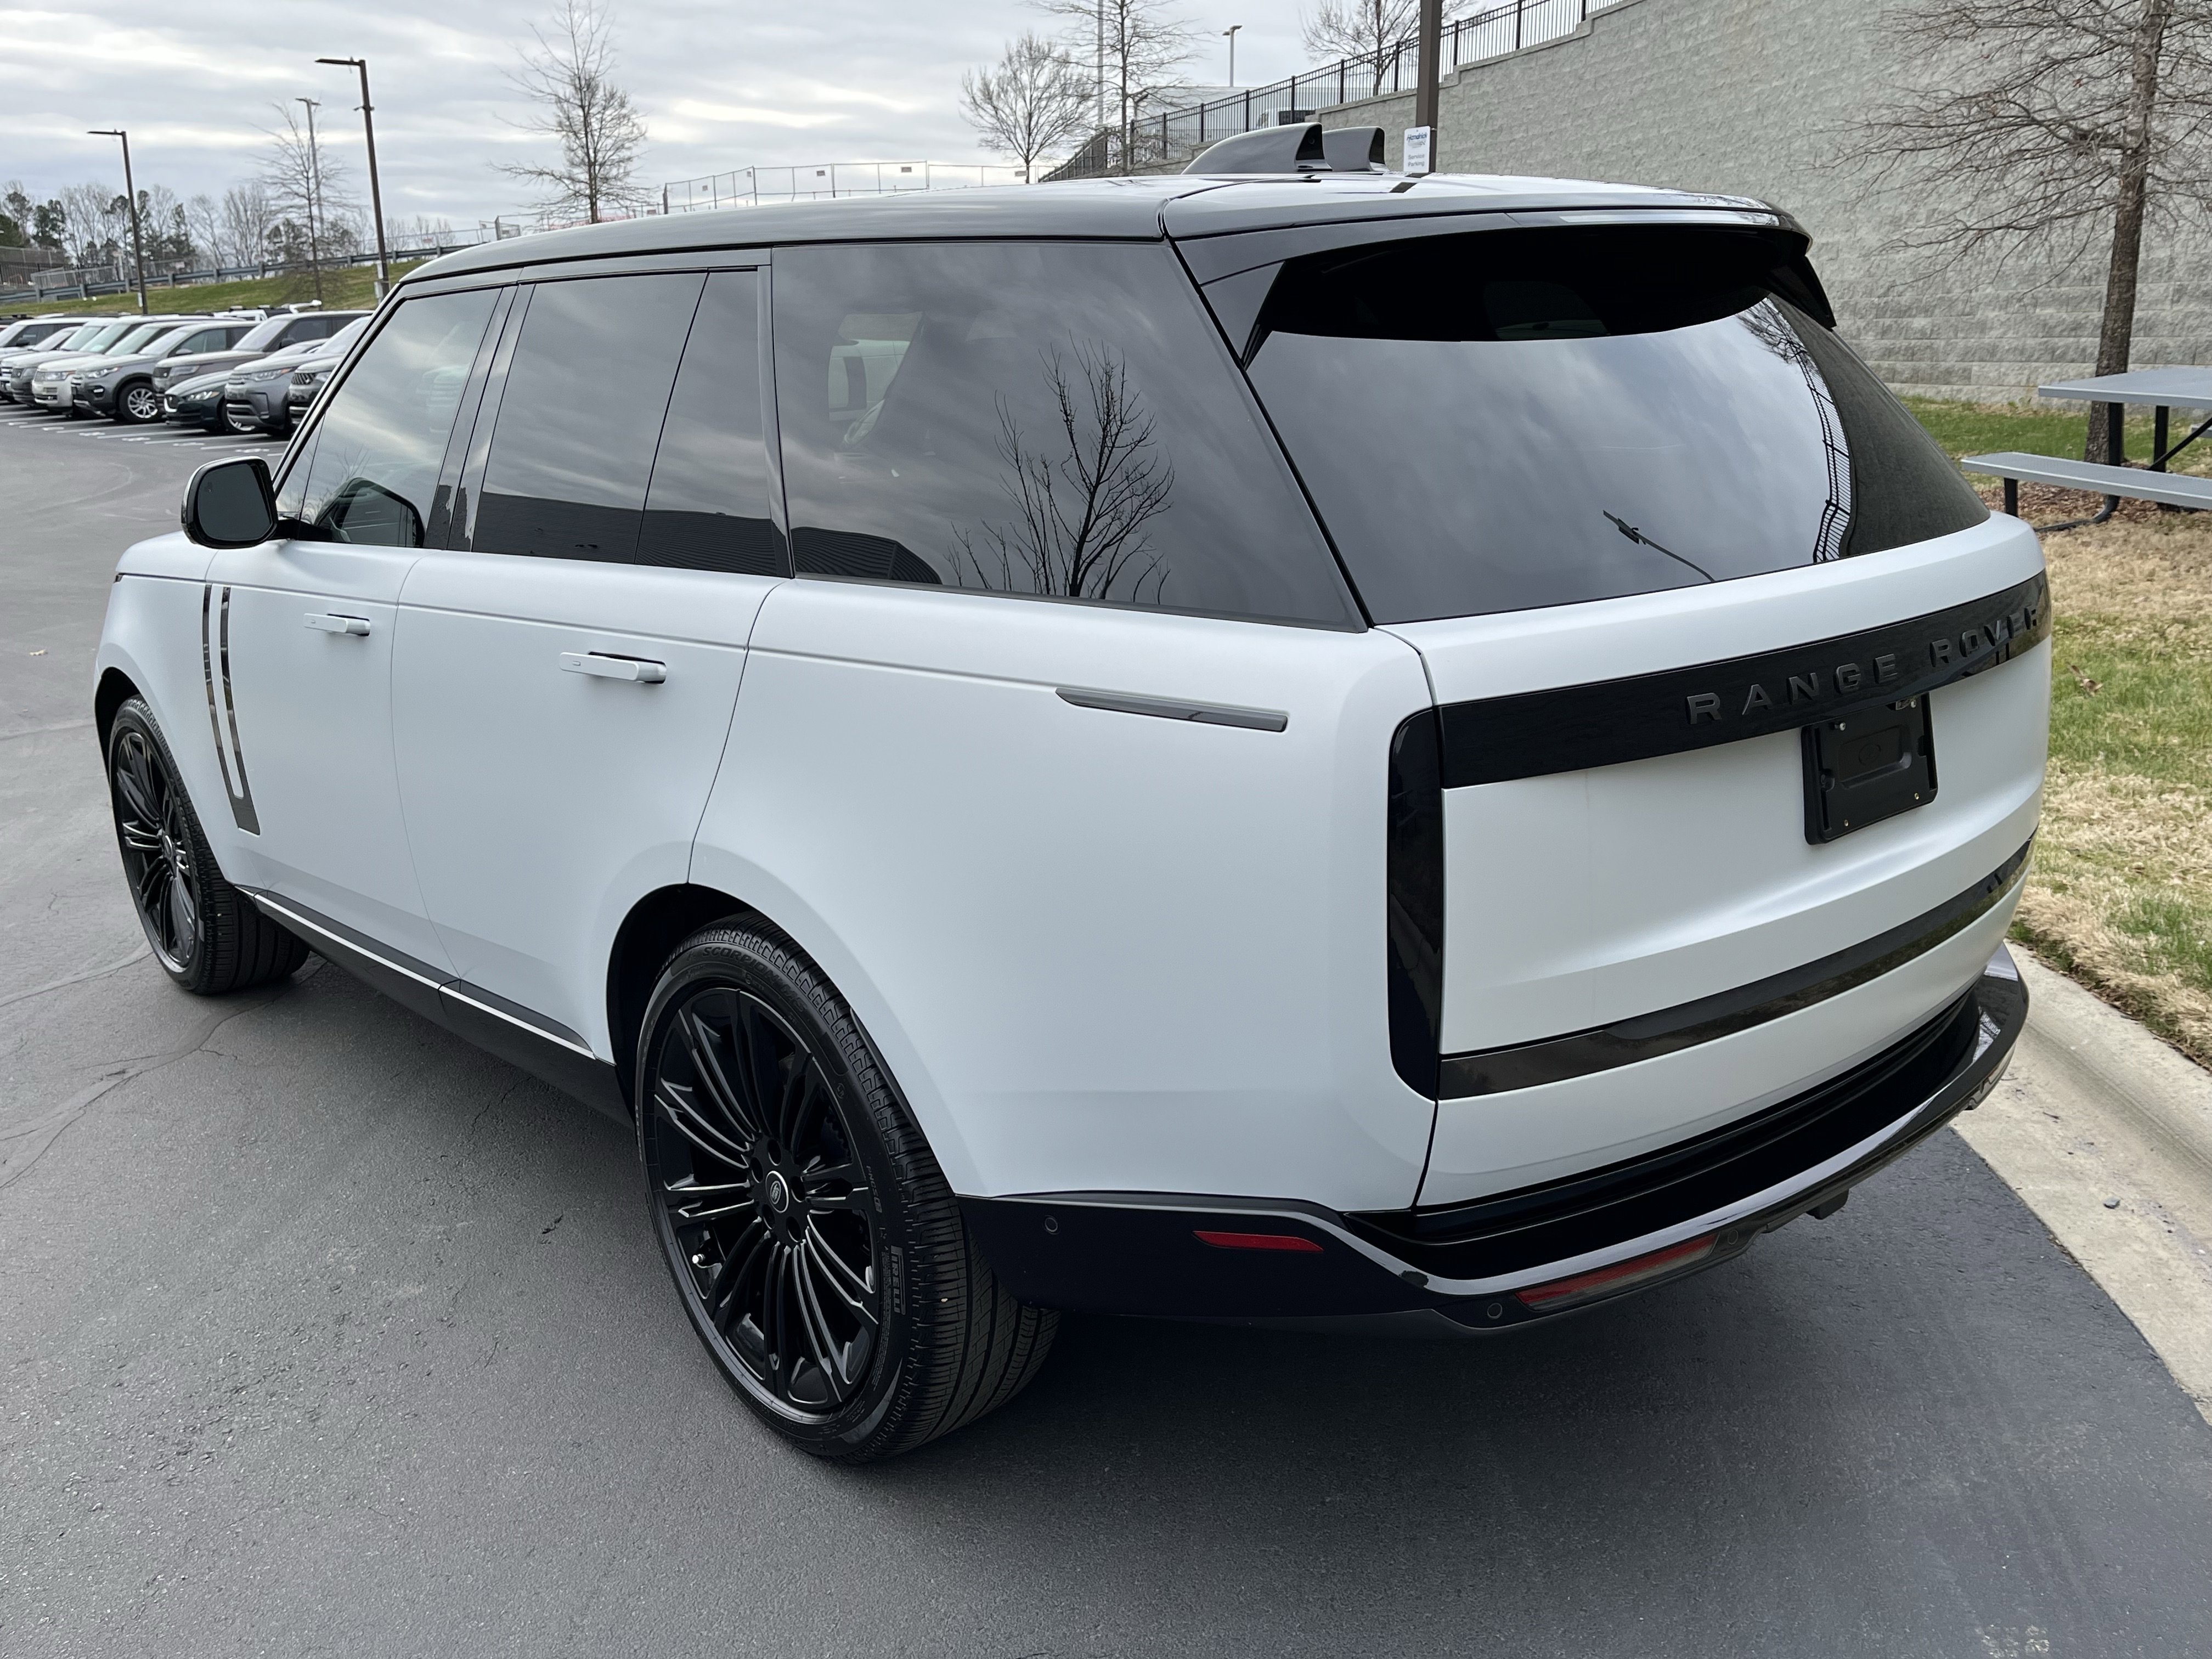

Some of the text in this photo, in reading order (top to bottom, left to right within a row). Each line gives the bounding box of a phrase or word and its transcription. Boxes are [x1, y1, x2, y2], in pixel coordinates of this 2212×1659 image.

[1407, 132, 1427, 141] Hendrick
[1686, 605, 2038, 725] RANGE ROVER
[890, 1245, 906, 1316] PIRELLI
